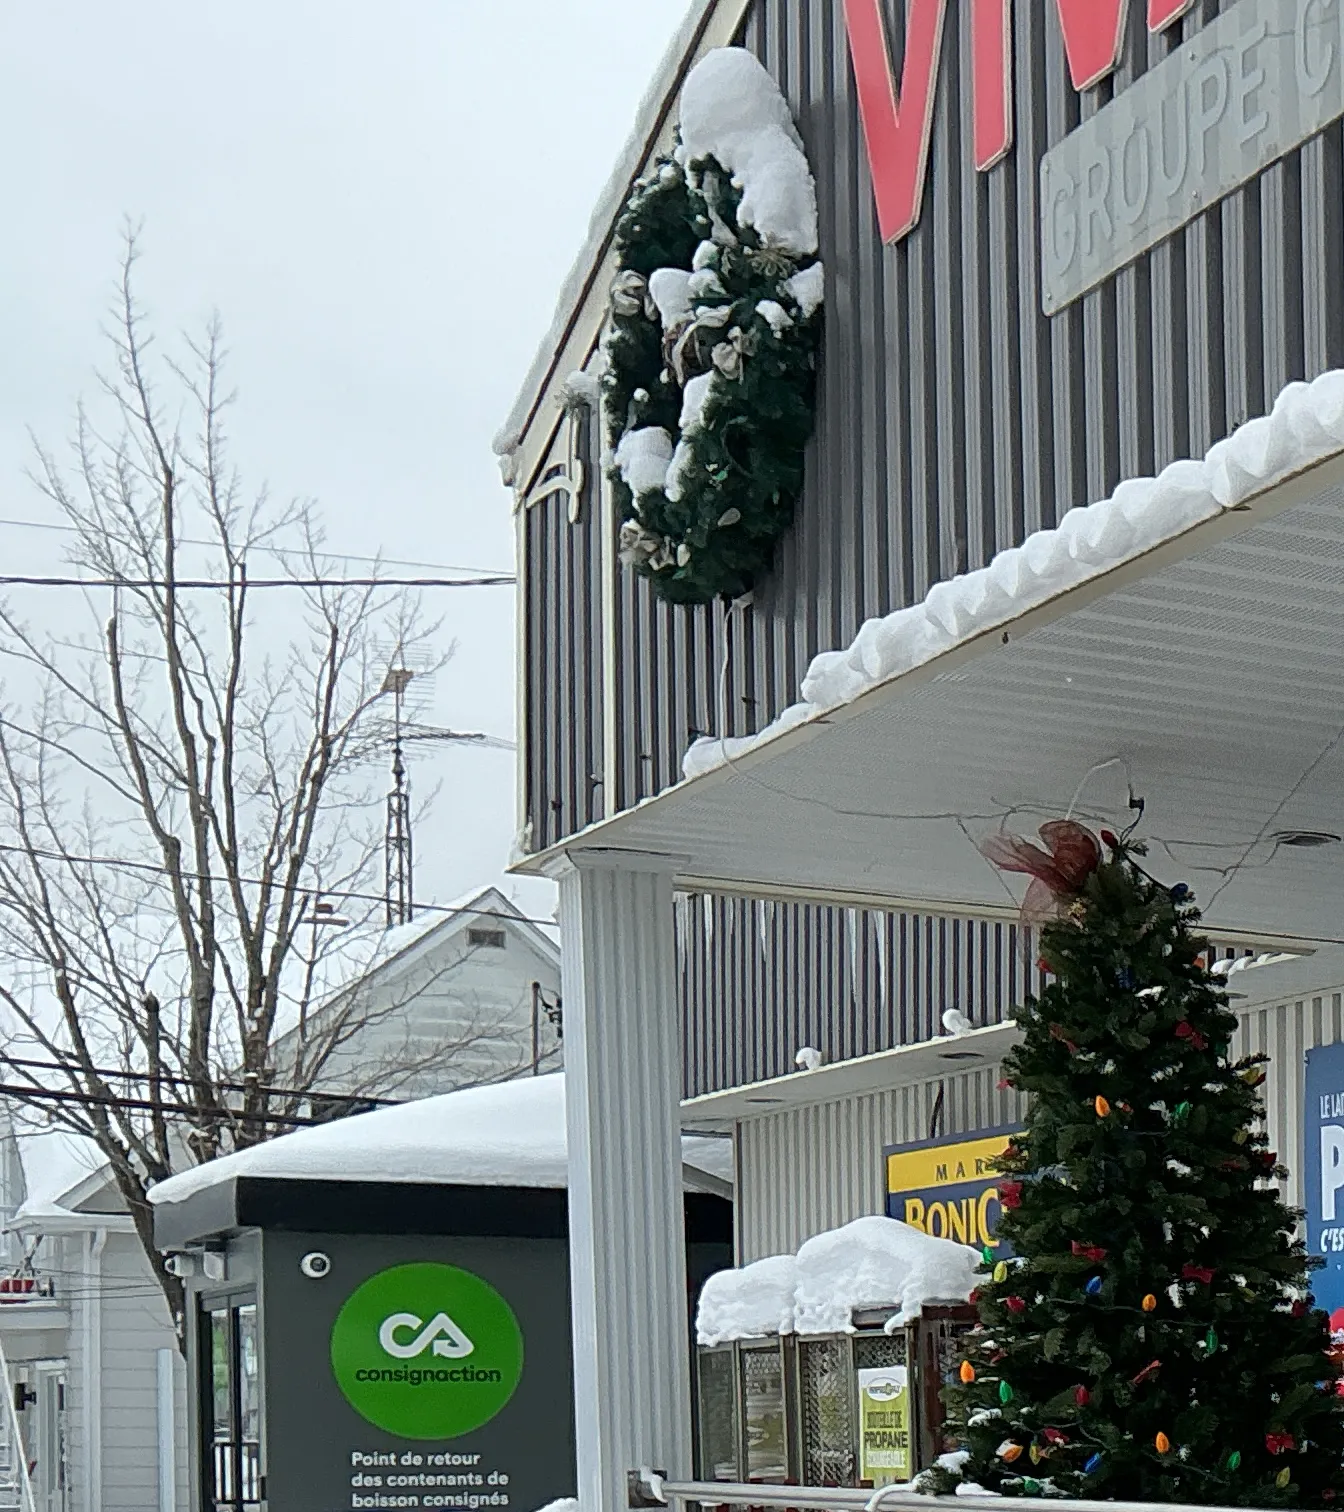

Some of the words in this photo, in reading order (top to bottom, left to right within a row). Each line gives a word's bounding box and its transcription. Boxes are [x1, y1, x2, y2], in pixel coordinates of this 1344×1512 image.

[1047, 18, 1270, 278] GROUPE
[1319, 1095, 1330, 1119] LE
[379, 1312, 475, 1359] CA
[355, 1364, 502, 1386] consignaction
[863, 1430, 908, 1449] PROPANE
[351, 1451, 397, 1466] Point
[400, 1451, 423, 1466] de
[427, 1452, 481, 1466] retour
[351, 1472, 383, 1487] des
[386, 1472, 483, 1487] contenants
[487, 1471, 509, 1486] de
[351, 1492, 418, 1508] boisson
[422, 1491, 509, 1509] consignés
